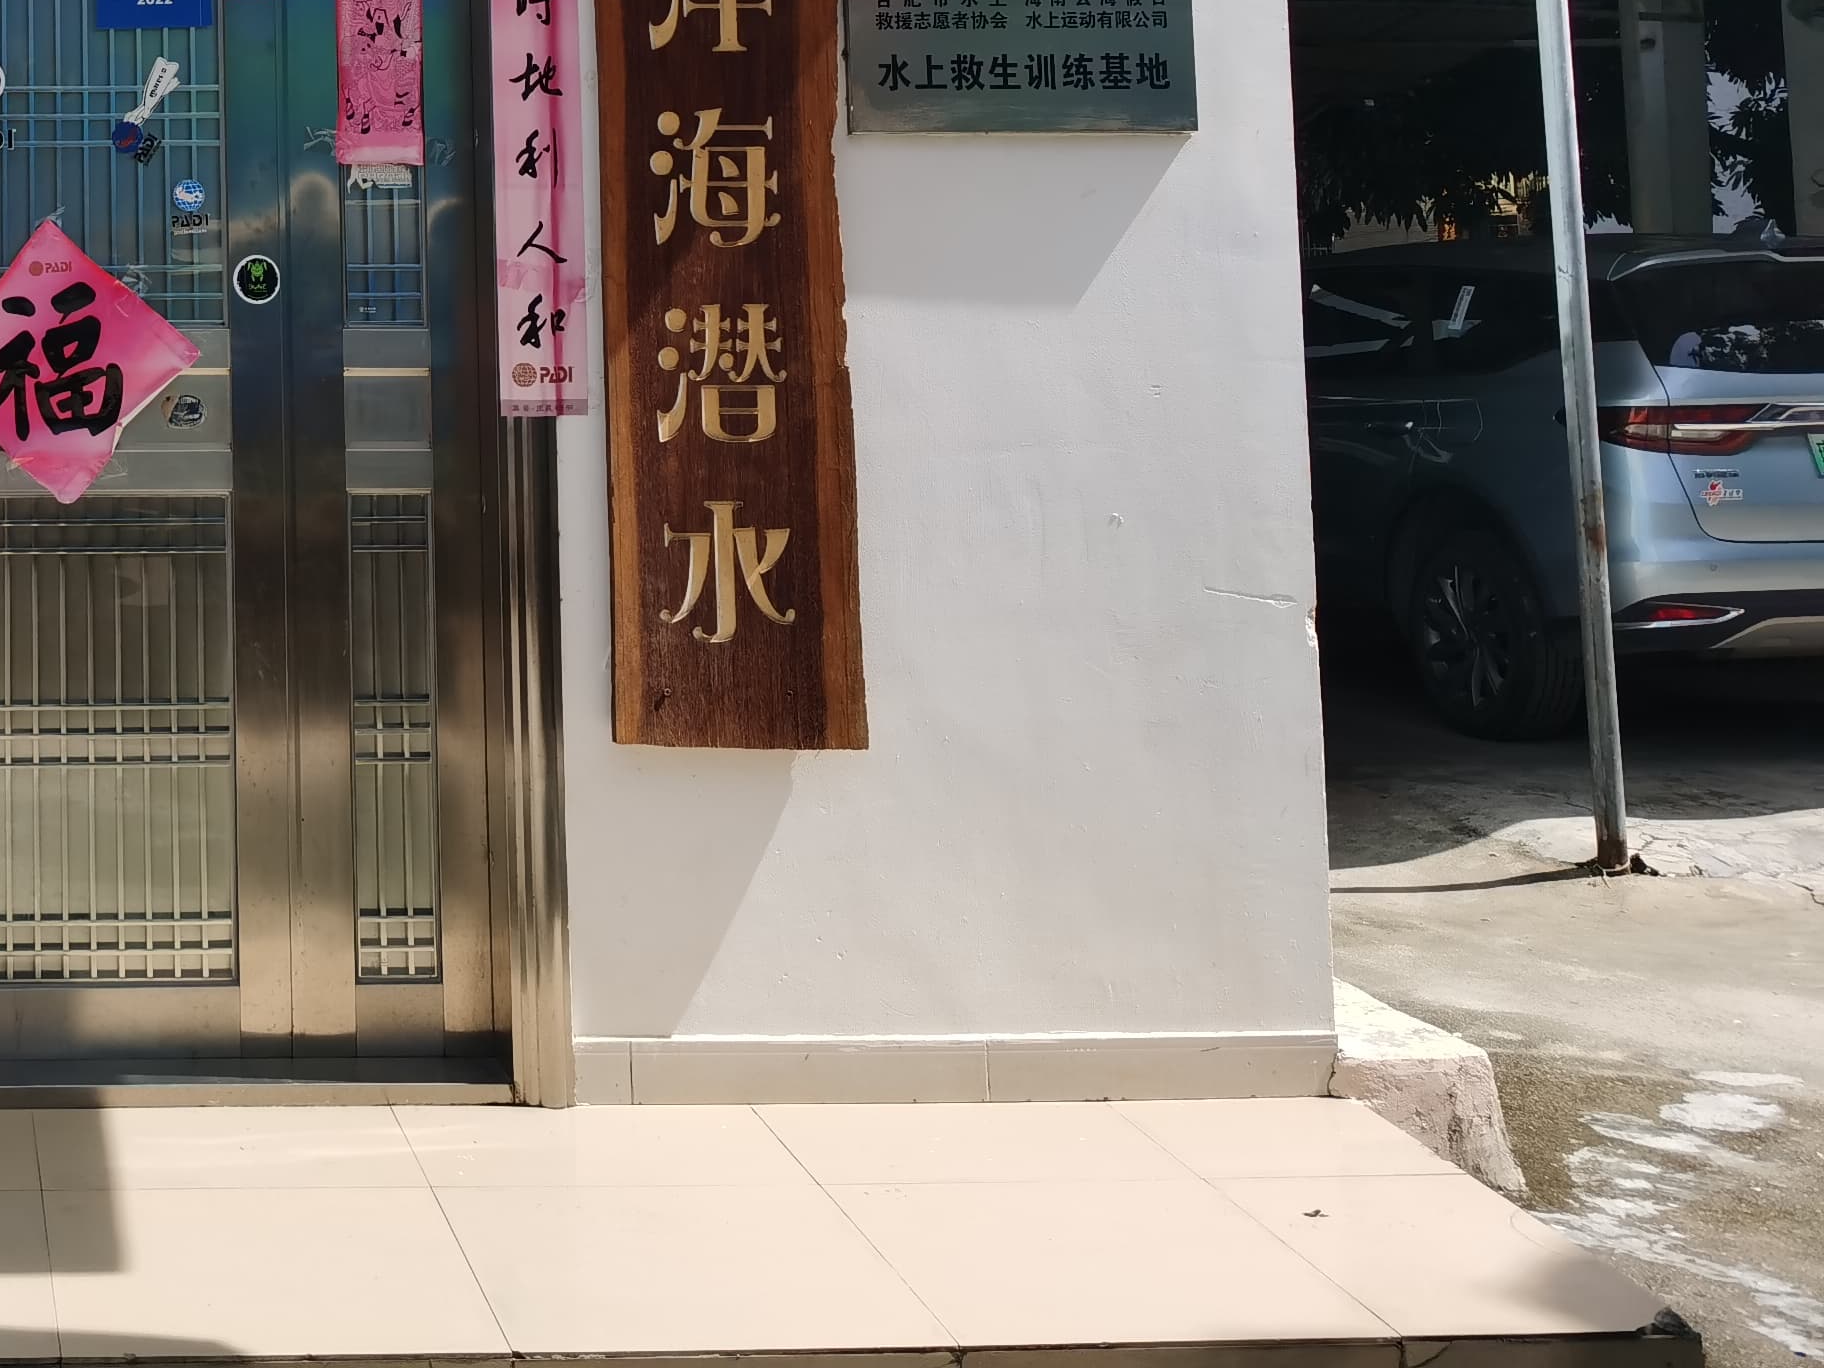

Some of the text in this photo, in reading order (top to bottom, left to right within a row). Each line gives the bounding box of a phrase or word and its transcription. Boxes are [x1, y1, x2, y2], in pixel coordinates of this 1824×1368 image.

[876, 11, 1168, 30] 救援志愿者协会 水上运动有限公司
[878, 52, 1171, 91] 水上救生训练基地
[134, 133, 159, 165] PADI
[170, 214, 210, 228] PADI
[45, 262, 72, 273] PADI
[540, 366, 573, 383] PADI
